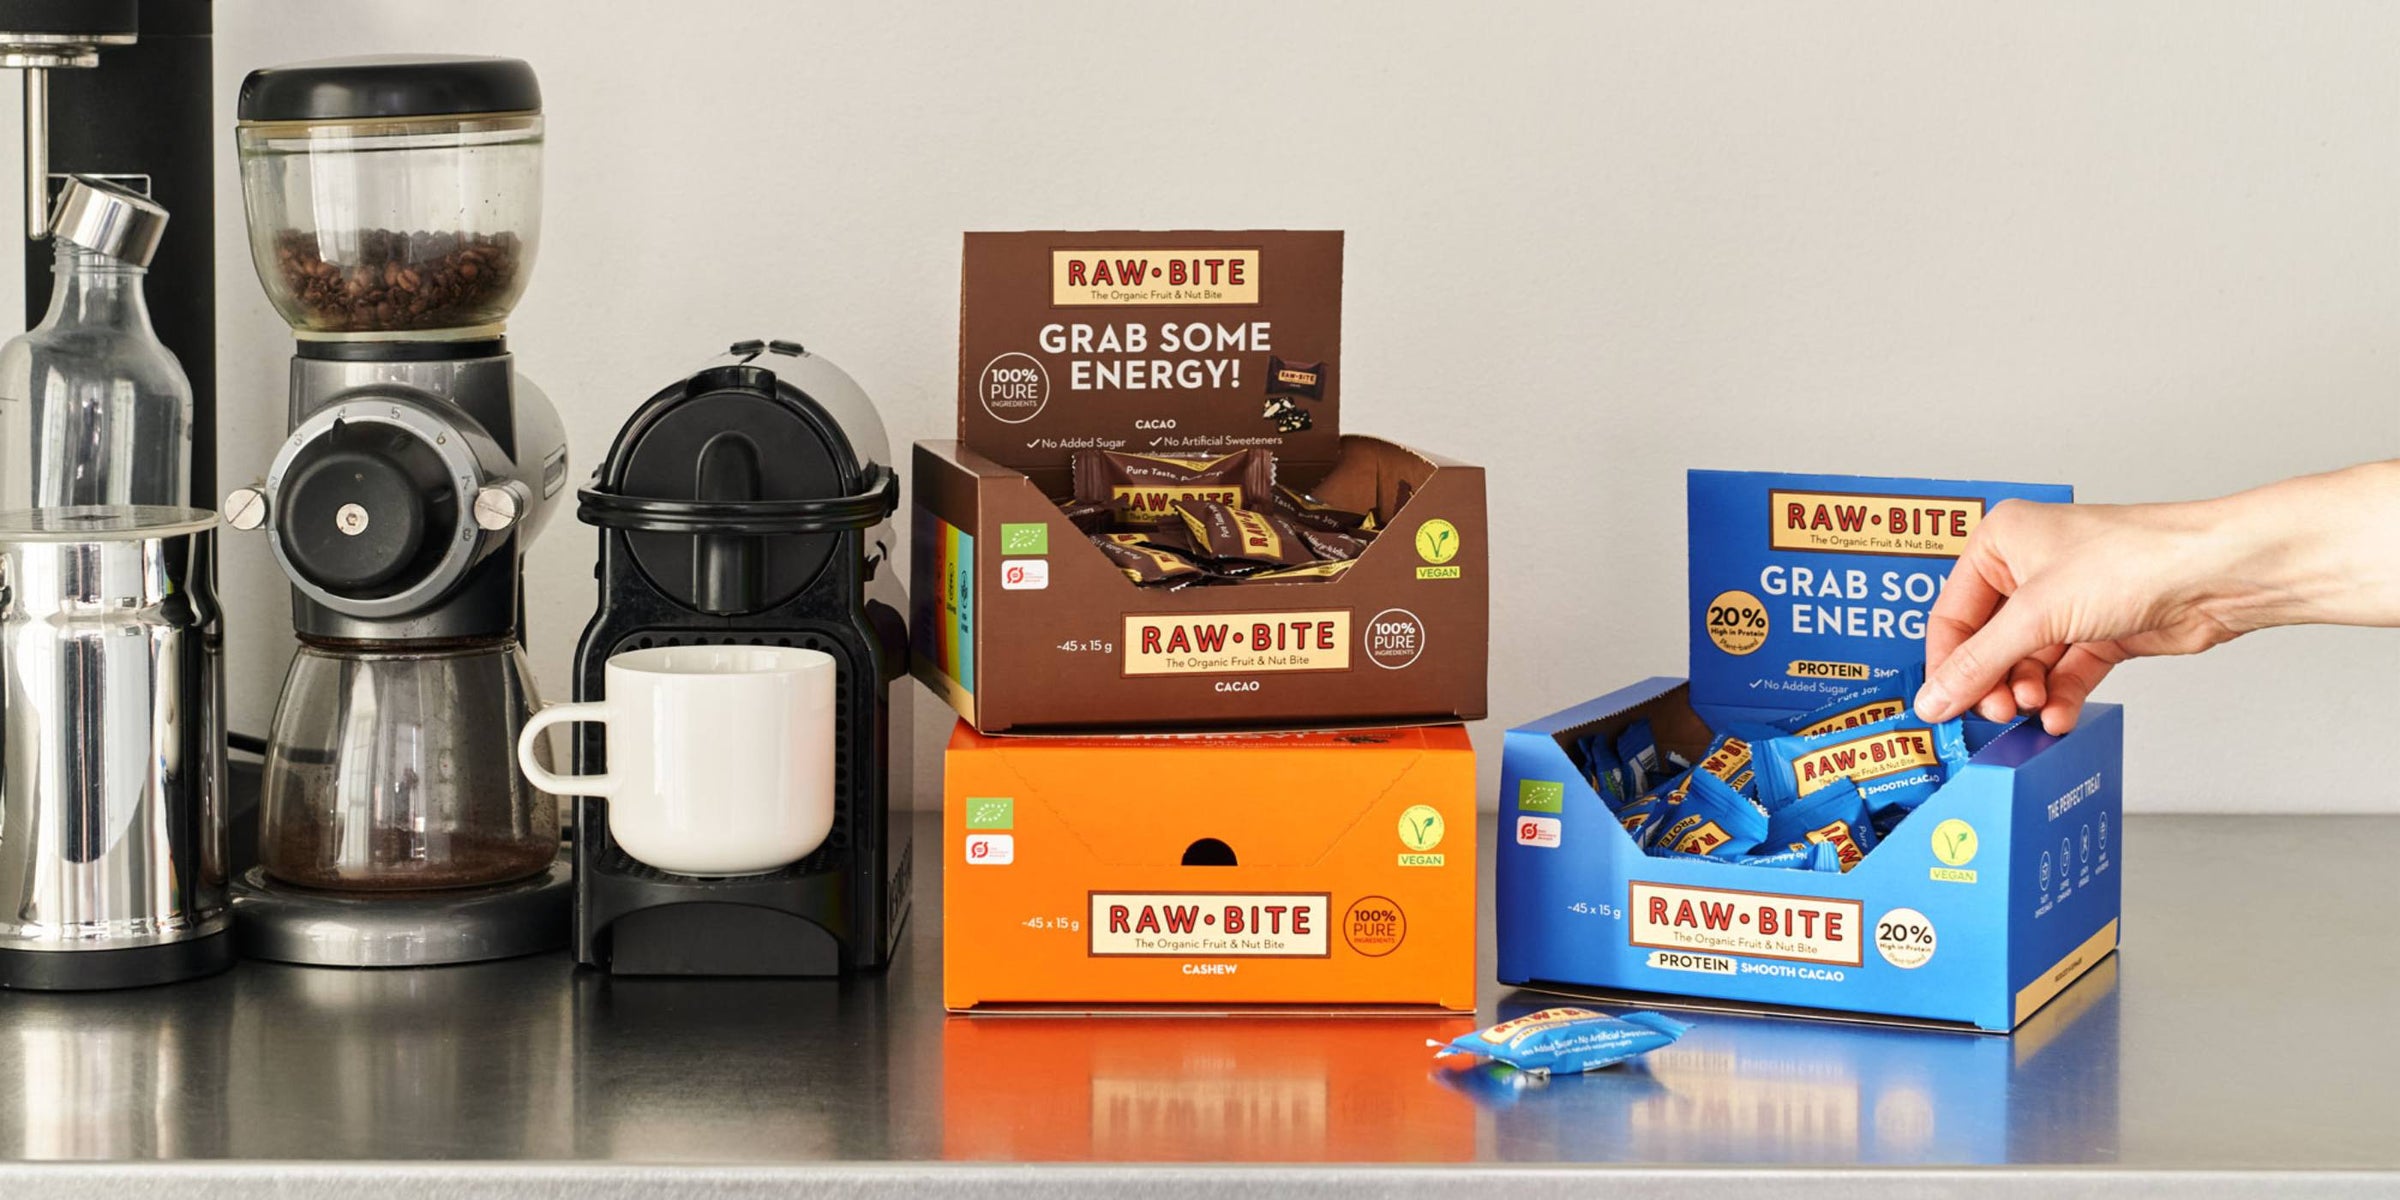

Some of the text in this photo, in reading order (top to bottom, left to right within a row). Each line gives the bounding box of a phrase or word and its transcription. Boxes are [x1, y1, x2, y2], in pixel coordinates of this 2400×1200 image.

[1091, 289, 1222, 301] The Organic Fruit & Nut Bite
[1039, 322, 1271, 353] GRAB SOME
[991, 368, 1039, 383] 100%
[1071, 359, 1240, 390] ENERGY!
[991, 383, 1039, 399] PURE
[991, 400, 1038, 408] INGREDIENTS
[1135, 419, 1177, 430] CACAO
[436, 432, 446, 445] 6
[1041, 434, 1283, 450] No Added Sugar No Artificial Sweeteners
[1126, 465, 1149, 475] Pure
[462, 475, 472, 490] 7
[462, 528, 472, 541] 8
[1810, 534, 1944, 550] The Organic Fruit & Nut Bite
[1419, 568, 1458, 577] VEGAN
[1760, 565, 1949, 603] GRAB SO
[1710, 606, 1766, 628] 20%
[1792, 603, 1931, 640] ENERG
[1375, 622, 1416, 635] 100%
[1710, 628, 1728, 637] High
[1738, 629, 1765, 637] Protein
[1090, 640, 1101, 651] 15
[1104, 643, 1112, 654] g
[1374, 635, 1415, 649] PURE
[1166, 654, 1310, 670] The Organic Fruit & Nut Bite
[1798, 662, 1899, 678] PROTEIN SMO
[1215, 681, 1260, 692] CACAO
[1764, 680, 1849, 694] No Added Sugar
[1886, 761, 1900, 771] Nut
[1900, 758, 1915, 768] Bite
[1868, 774, 1940, 795] SMOOTH CACAO
[2047, 772, 2101, 822] THE PERFECT TREAT
[1659, 818, 1697, 848] PROTEI
[1401, 855, 1442, 865] VEGAN
[1933, 869, 1975, 881] VEGAN
[1354, 910, 1396, 922] 100%
[1599, 904, 1611, 915] 15
[1613, 909, 1621, 920] g
[1056, 917, 1068, 928] 15
[1071, 920, 1079, 931] g
[1354, 923, 1396, 936] PURE
[1879, 922, 1932, 944] 20%
[1136, 938, 1285, 950] The Organic Fruit & Nut Bite
[1673, 931, 1818, 954] The Organic Fruit & Nut Bite
[1182, 964, 1238, 975] CASHEW
[1659, 953, 1844, 982] PROTEIN SMOOTH CACAO
